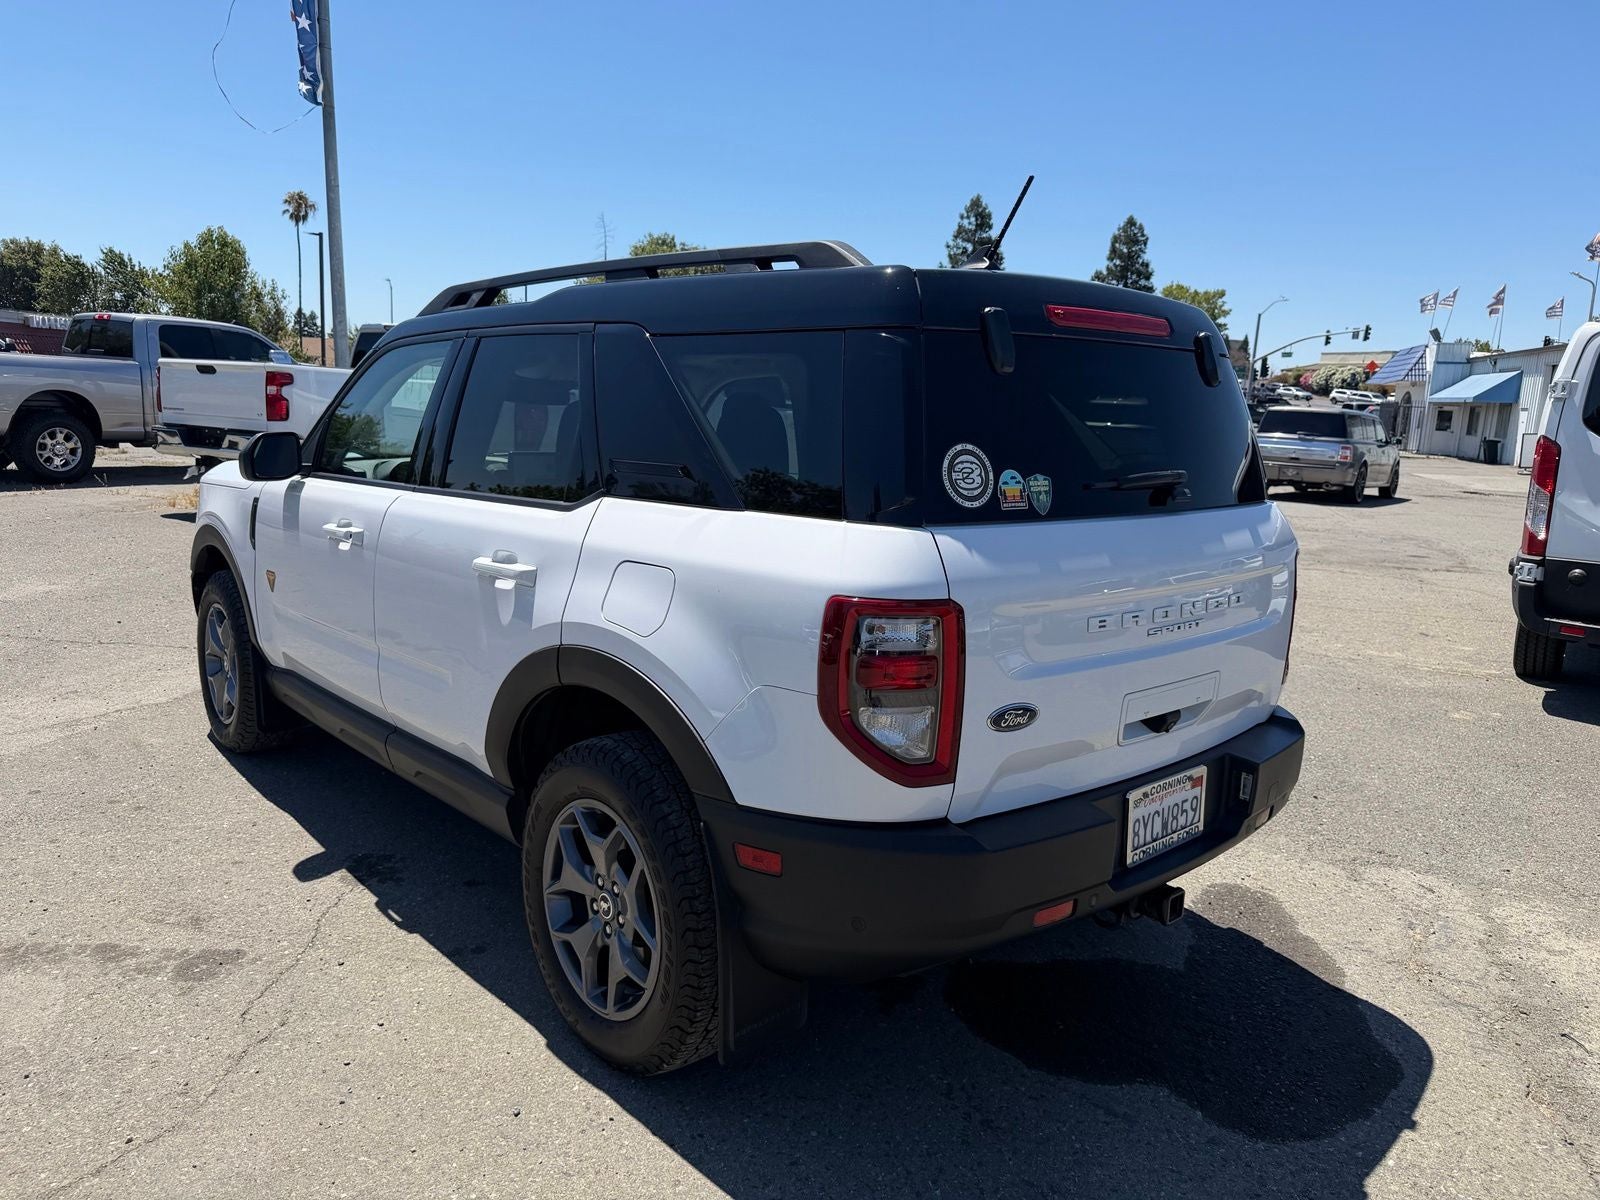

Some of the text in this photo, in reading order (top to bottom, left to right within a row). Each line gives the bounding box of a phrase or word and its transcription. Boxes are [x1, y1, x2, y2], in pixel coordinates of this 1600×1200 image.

[946, 447, 958, 461] UNION
[1086, 591, 1245, 633] BRONCO
[1147, 618, 1204, 637] SPORT
[1001, 709, 1030, 727] Ford
[1150, 774, 1188, 796] CORNING
[1132, 796, 1199, 850] 8YCW859
[1131, 825, 1200, 864] CORNING FORD
